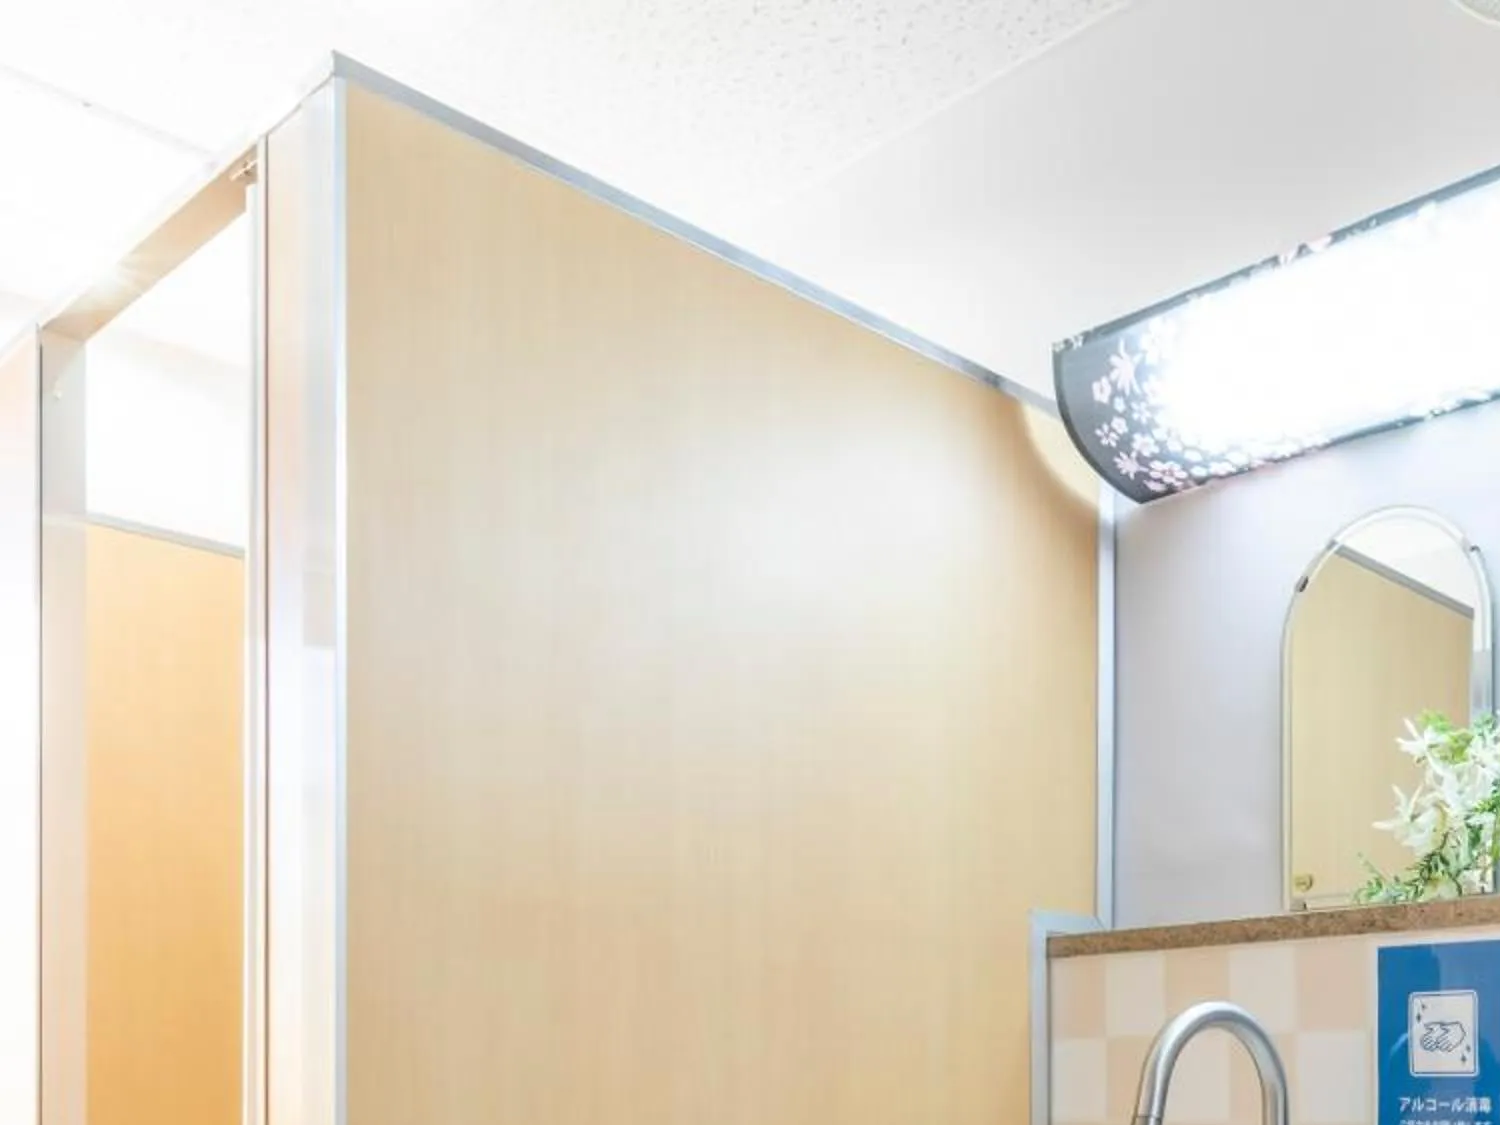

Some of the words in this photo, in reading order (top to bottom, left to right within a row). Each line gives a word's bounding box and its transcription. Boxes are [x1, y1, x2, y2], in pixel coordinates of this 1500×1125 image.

[1399, 1096, 1492, 1113] アルコール消毒
